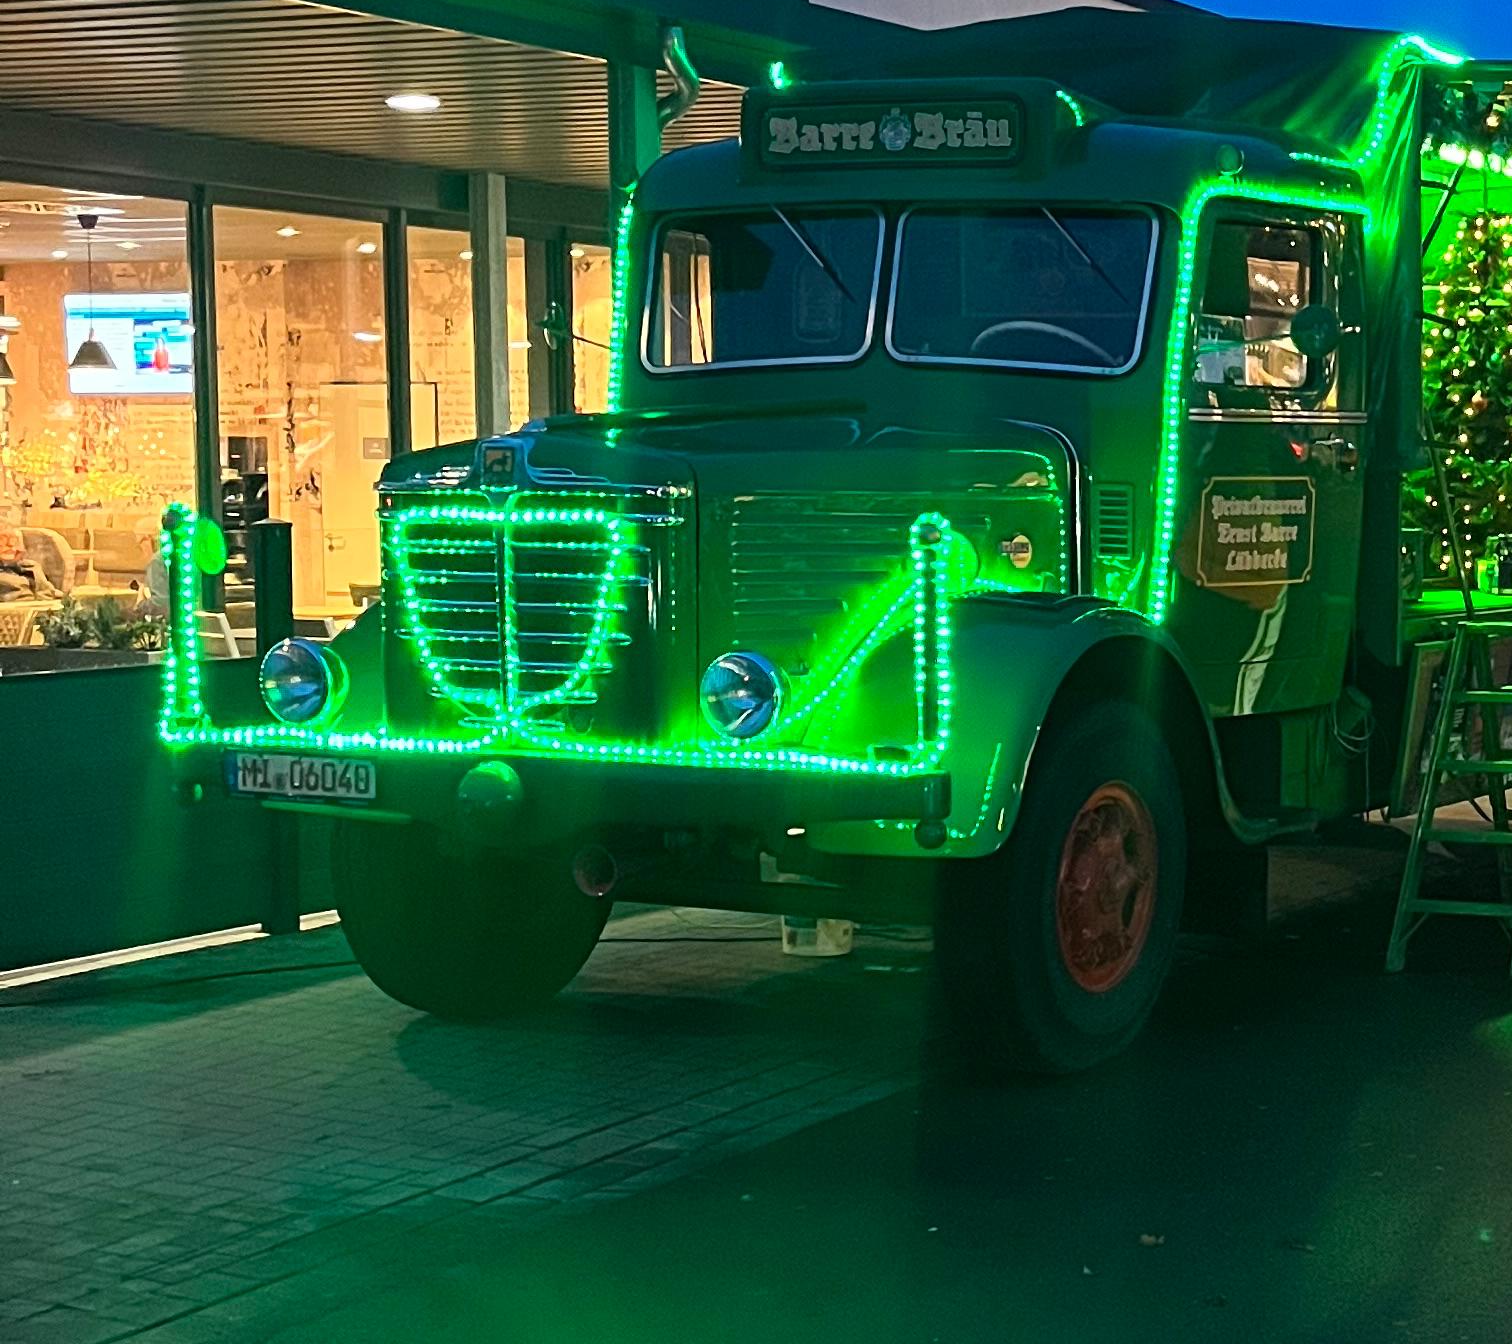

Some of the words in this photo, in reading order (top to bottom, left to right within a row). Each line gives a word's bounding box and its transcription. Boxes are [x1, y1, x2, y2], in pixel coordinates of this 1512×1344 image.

[769, 116, 876, 154] Barre
[913, 111, 1012, 150] Bräu
[1260, 522, 1298, 543] Barre
[240, 757, 271, 789] MI
[289, 759, 370, 794] 06040
